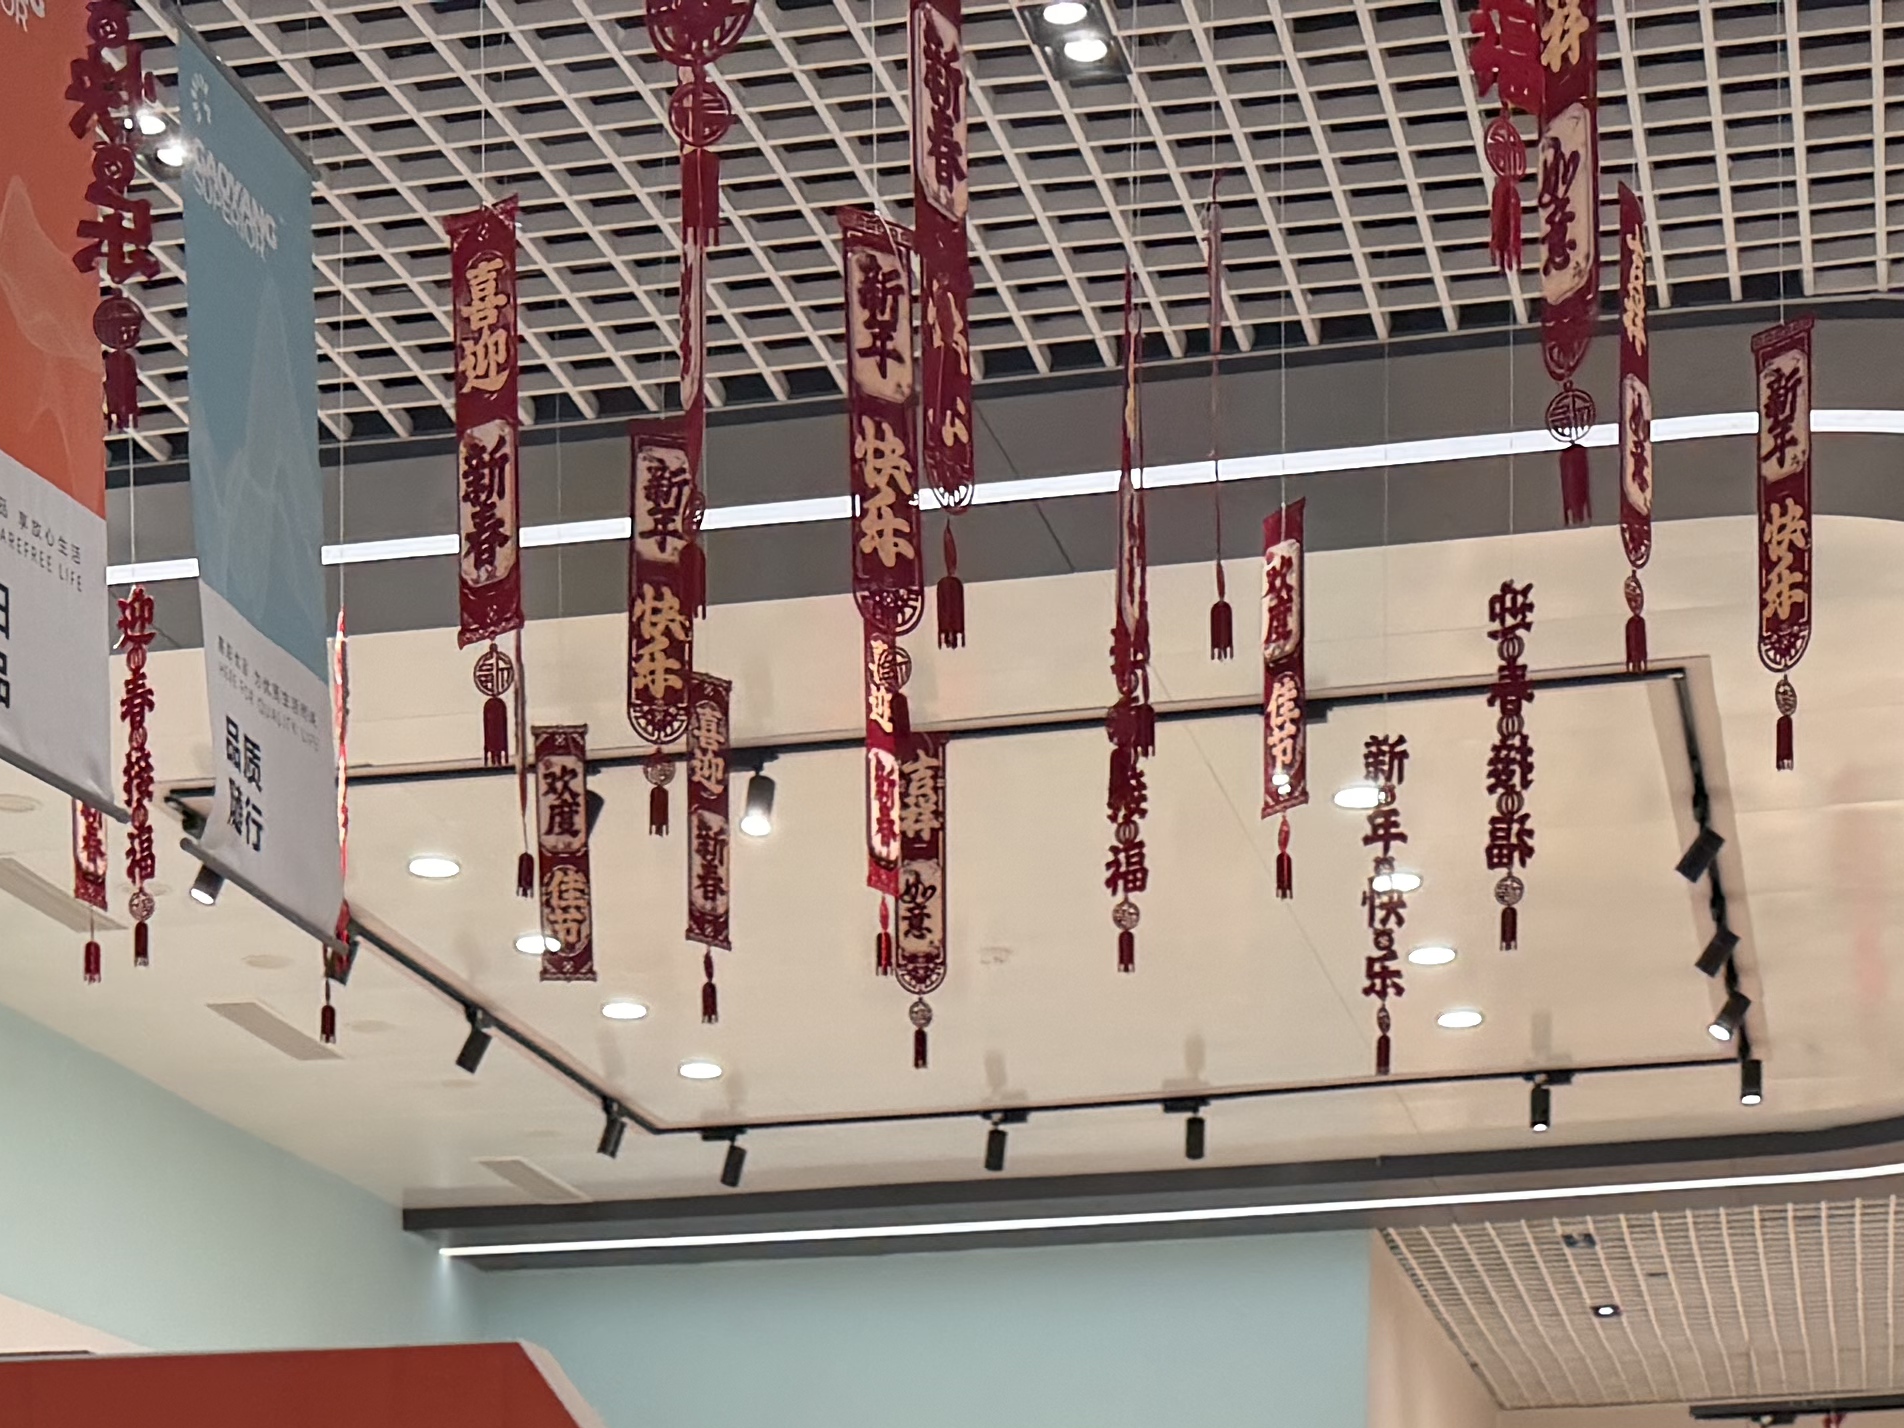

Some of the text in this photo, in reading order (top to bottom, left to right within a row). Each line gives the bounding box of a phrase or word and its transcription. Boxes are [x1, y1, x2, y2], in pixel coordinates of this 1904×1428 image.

[458, 257, 510, 573] 喜迎新春
[855, 252, 915, 568] 新年快乐
[1762, 367, 1809, 620] 新年快乐
[631, 462, 692, 700] 新年快乐
[1264, 555, 1302, 773] 欢度佳节
[225, 713, 263, 795] 品质
[542, 765, 588, 945] 欢度佳节
[690, 705, 728, 902] 喜迎新春
[897, 749, 941, 940] 吉祥如意
[1362, 734, 1410, 999] 新年快乐
